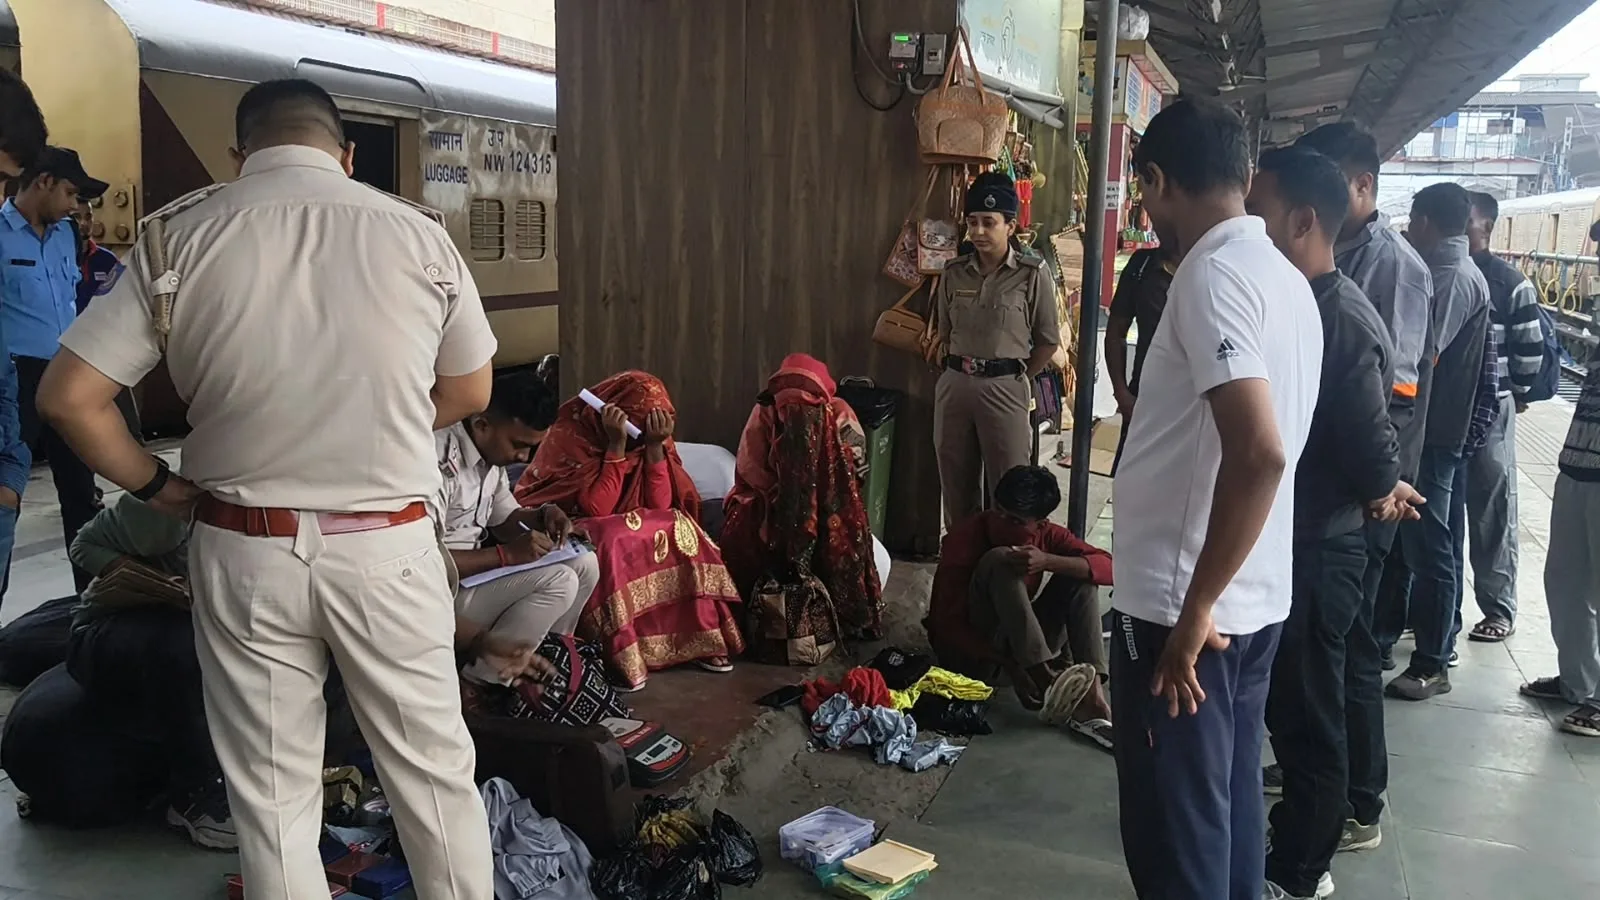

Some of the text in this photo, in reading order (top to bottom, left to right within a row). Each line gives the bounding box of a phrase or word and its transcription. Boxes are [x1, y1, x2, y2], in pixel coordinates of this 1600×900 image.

[428, 131, 463, 151] सामान
[484, 151, 552, 174] NW 124315
[425, 163, 468, 184] LUGGAGE
